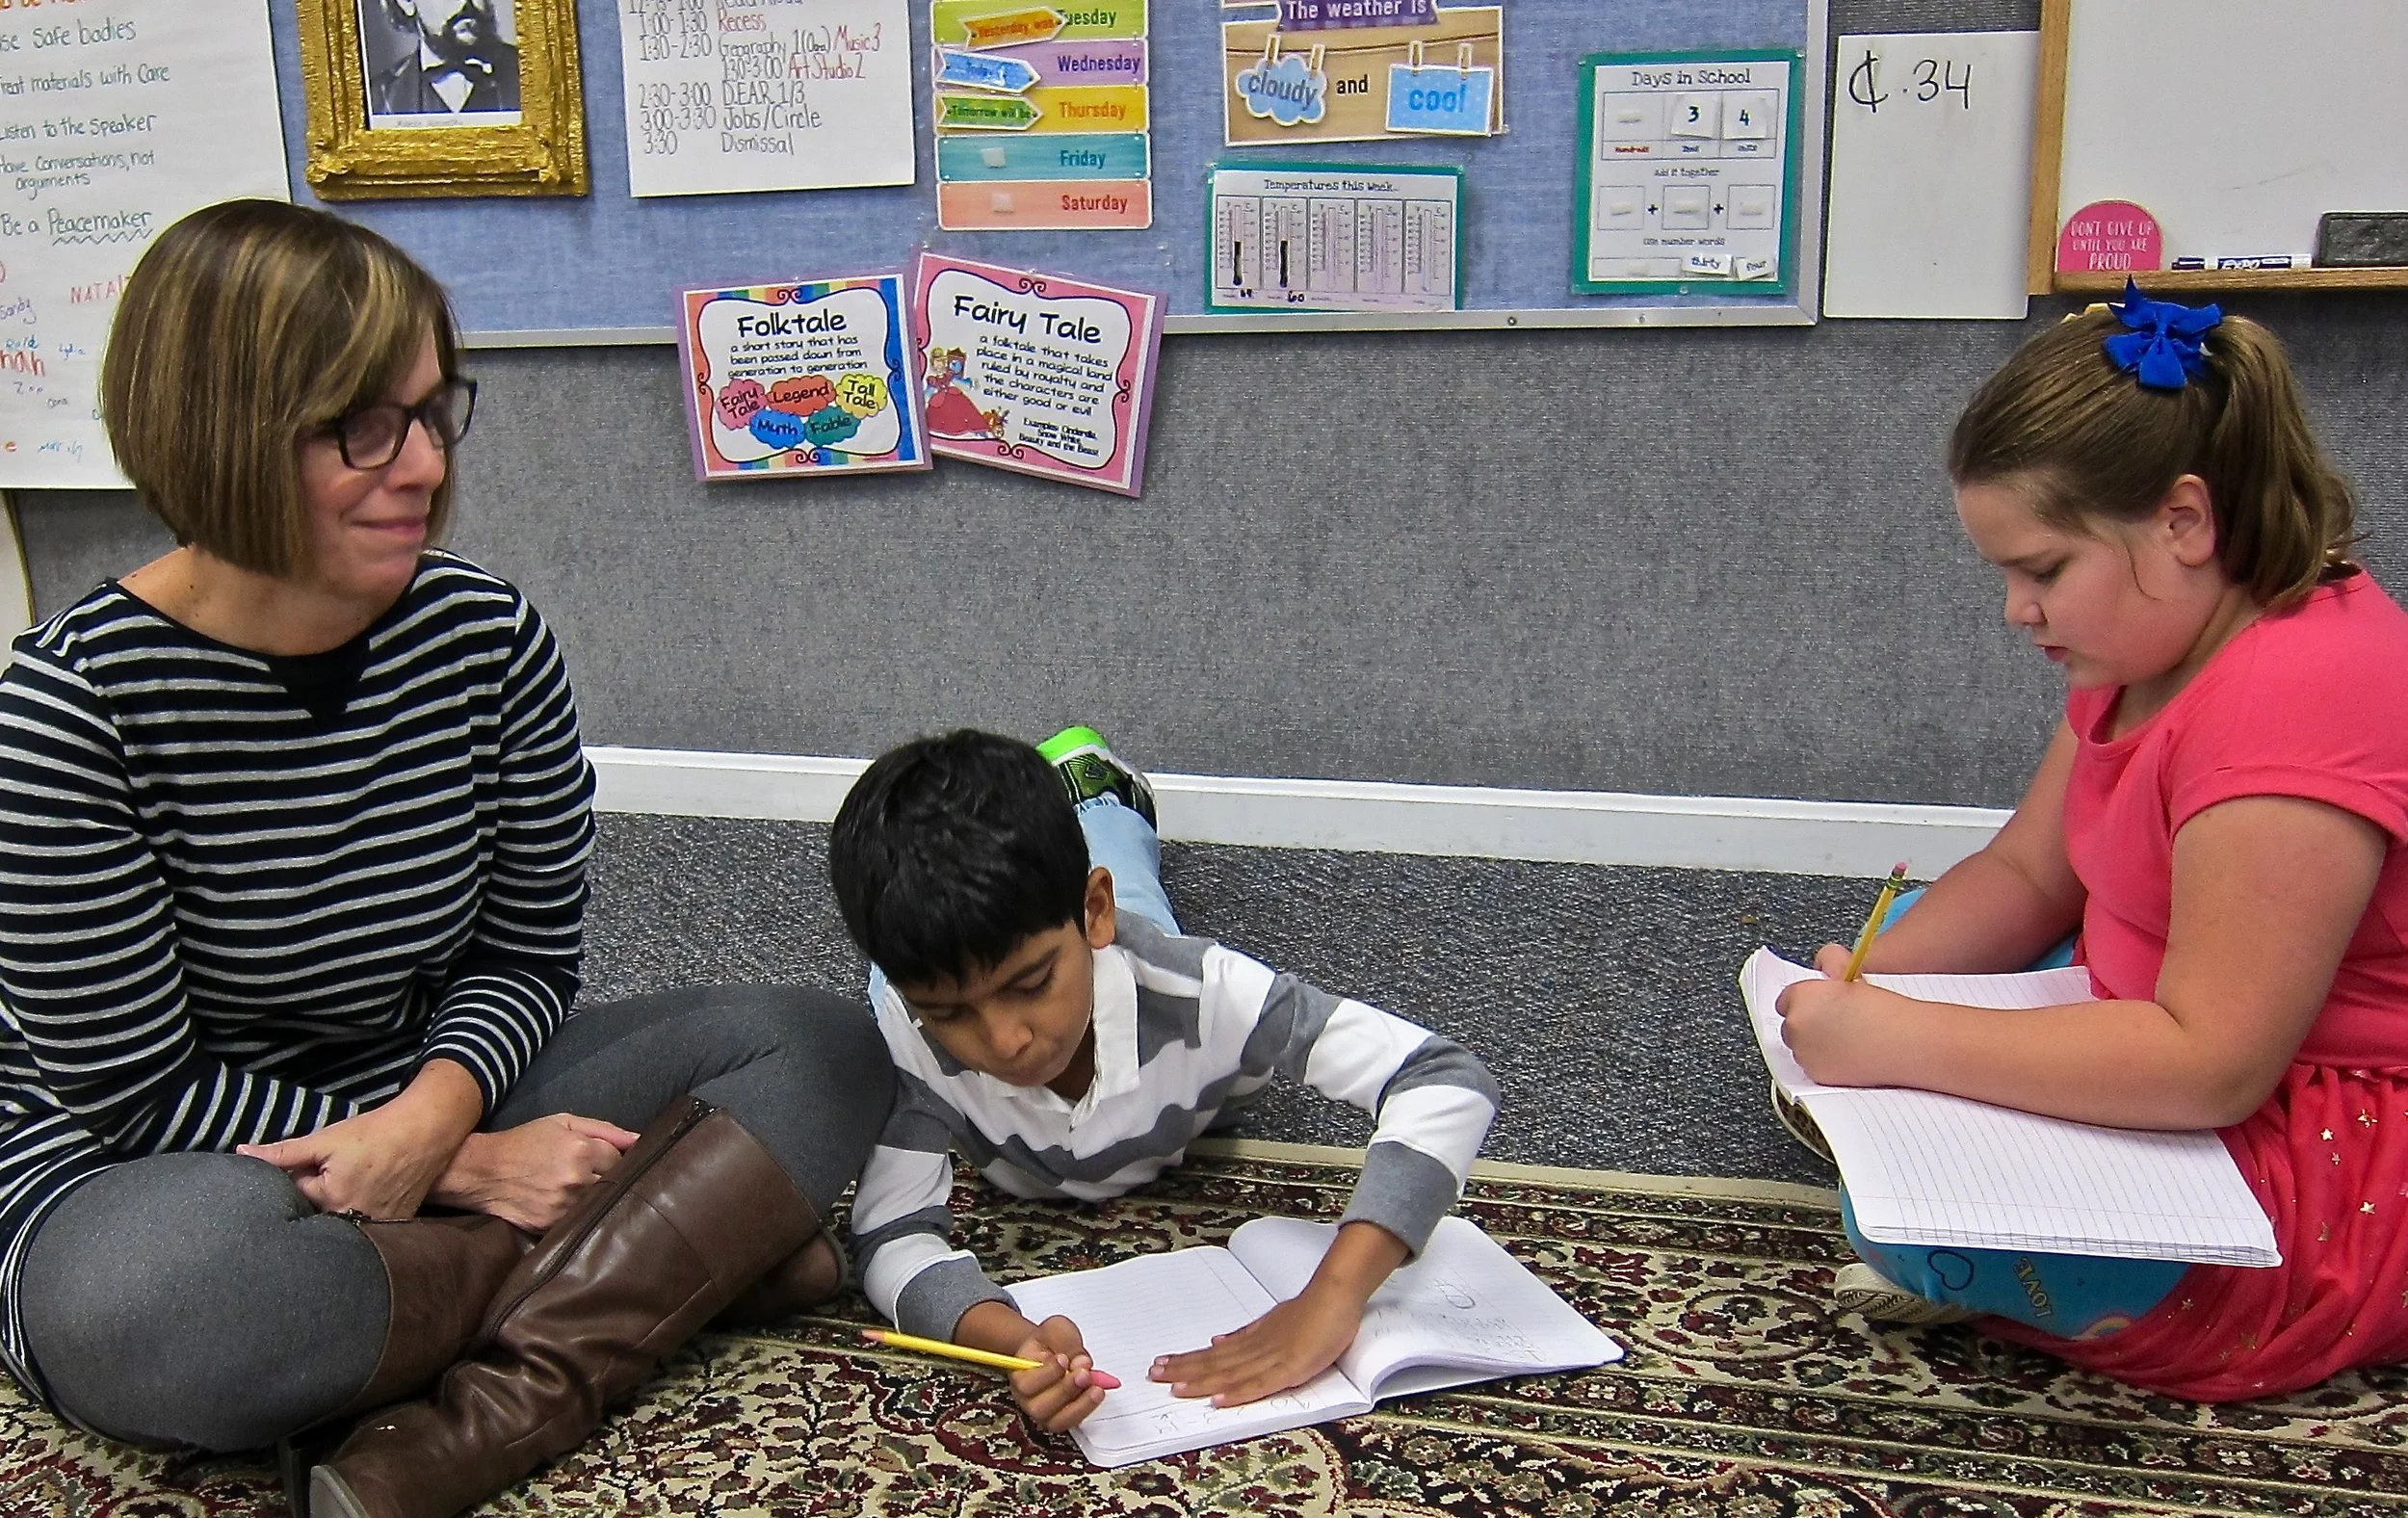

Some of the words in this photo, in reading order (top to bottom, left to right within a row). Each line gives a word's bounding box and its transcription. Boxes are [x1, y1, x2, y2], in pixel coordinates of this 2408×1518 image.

[1286, 1, 1318, 20] The
[1326, 0, 1402, 18] weather
[718, 10, 768, 32] Recess
[0, 35, 20, 51] se
[33, 26, 71, 48] Safe
[77, 16, 137, 45] bodies
[718, 31, 786, 63] Geography
[834, 25, 870, 52] Music
[787, 55, 810, 79] Art
[1058, 54, 1140, 74] Wednesday
[0, 75, 24, 94] reat
[31, 70, 93, 92] materials
[100, 64, 132, 86] with
[1632, 70, 1672, 88] Days
[1677, 70, 1692, 85] in
[1698, 68, 1751, 84] School
[1247, 70, 1318, 112] cloudy
[1336, 74, 1369, 94] and
[1409, 84, 1466, 114] cool
[1060, 101, 1127, 121] Thursday
[1688, 105, 1700, 123] 3
[1739, 108, 1750, 127] 4
[42, 119, 58, 138] to
[60, 117, 86, 136] the
[130, 150, 155, 167] not
[1060, 149, 1107, 170] Friday
[15, 172, 92, 200] arguments
[1264, 178, 1340, 193] Temperatures
[1342, 179, 1365, 192] this
[1061, 195, 1128, 215] Saturday
[0, 212, 23, 236] Be
[28, 221, 40, 233] a
[48, 207, 153, 236] Peacemaker
[2107, 220, 2133, 237] GIVE
[2138, 220, 2155, 236] UP
[1662, 237, 1694, 246] number
[2073, 238, 2101, 251] UNTIL
[2106, 238, 2126, 251] YOU
[2131, 237, 2148, 252] ARE
[1691, 256, 1721, 270] thirty
[1745, 261, 1768, 272] four
[2088, 251, 2132, 271] PROUD
[1288, 290, 1305, 302] 60
[737, 308, 848, 338] Folktale
[954, 295, 1028, 334] Fairy
[1039, 312, 1102, 344] Tale
[743, 341, 771, 352] short
[774, 340, 803, 349] story
[807, 337, 833, 347] that
[837, 335, 858, 345] has
[980, 335, 988, 344] a
[993, 335, 1036, 353] folktale
[1041, 346, 1070, 359] that
[1074, 353, 1109, 367] takes
[730, 354, 757, 365] been
[761, 351, 798, 364] passed
[802, 350, 832, 360] down
[836, 348, 862, 357] from
[976, 347, 1008, 360] place
[1011, 353, 1023, 363] in
[1026, 357, 1034, 366] a
[1038, 359, 1083, 375] magical
[1086, 367, 1112, 381] land
[727, 366, 786, 379] generation
[790, 365, 803, 374] to
[806, 360, 868, 374] generation
[982, 361, 1010, 374] ruled
[1014, 367, 1029, 380] by
[1034, 372, 1077, 388] royalty
[1081, 381, 1106, 393] and
[772, 382, 830, 404] Legend
[848, 379, 876, 395] Tall
[984, 374, 1004, 385] the
[1008, 379, 1074, 400] characters
[1078, 394, 1100, 405] are
[720, 387, 759, 410] Fairy
[843, 390, 877, 410] Tale
[983, 386, 1019, 401] either
[1022, 396, 1052, 408] good
[1056, 402, 1068, 410] or
[1072, 405, 1092, 416] evil
[727, 400, 762, 420] Tale
[757, 418, 798, 436] Myth
[809, 415, 852, 434] Fable
[1037, 429, 1058, 439] Snow
[1018, 432, 1044, 447] Beauty
[1046, 440, 1061, 450] and
[1063, 442, 1076, 452] the
[2013, 1256, 2054, 1319] LOVE
